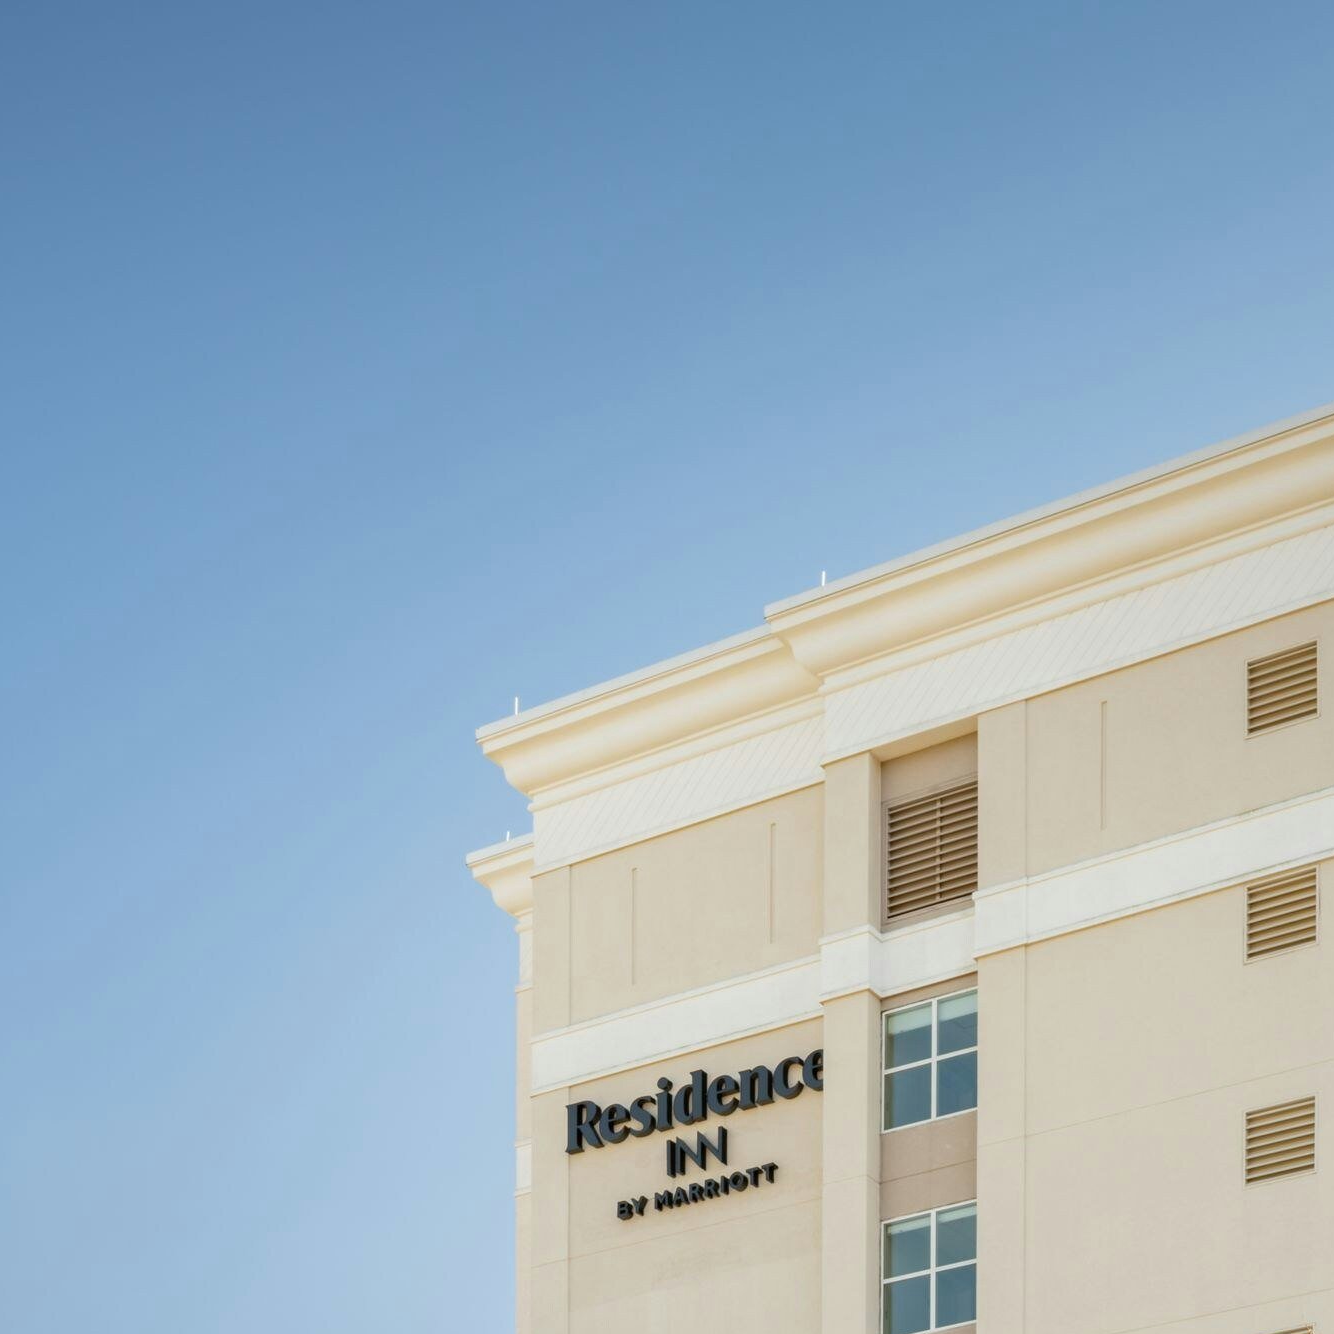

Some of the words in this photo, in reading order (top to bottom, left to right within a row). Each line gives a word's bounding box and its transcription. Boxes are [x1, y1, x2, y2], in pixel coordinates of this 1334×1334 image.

[565, 1048, 824, 1155] Residence
[667, 1126, 728, 1178] INN
[617, 1196, 648, 1221] BY
[654, 1162, 779, 1213] MARRIOTT
